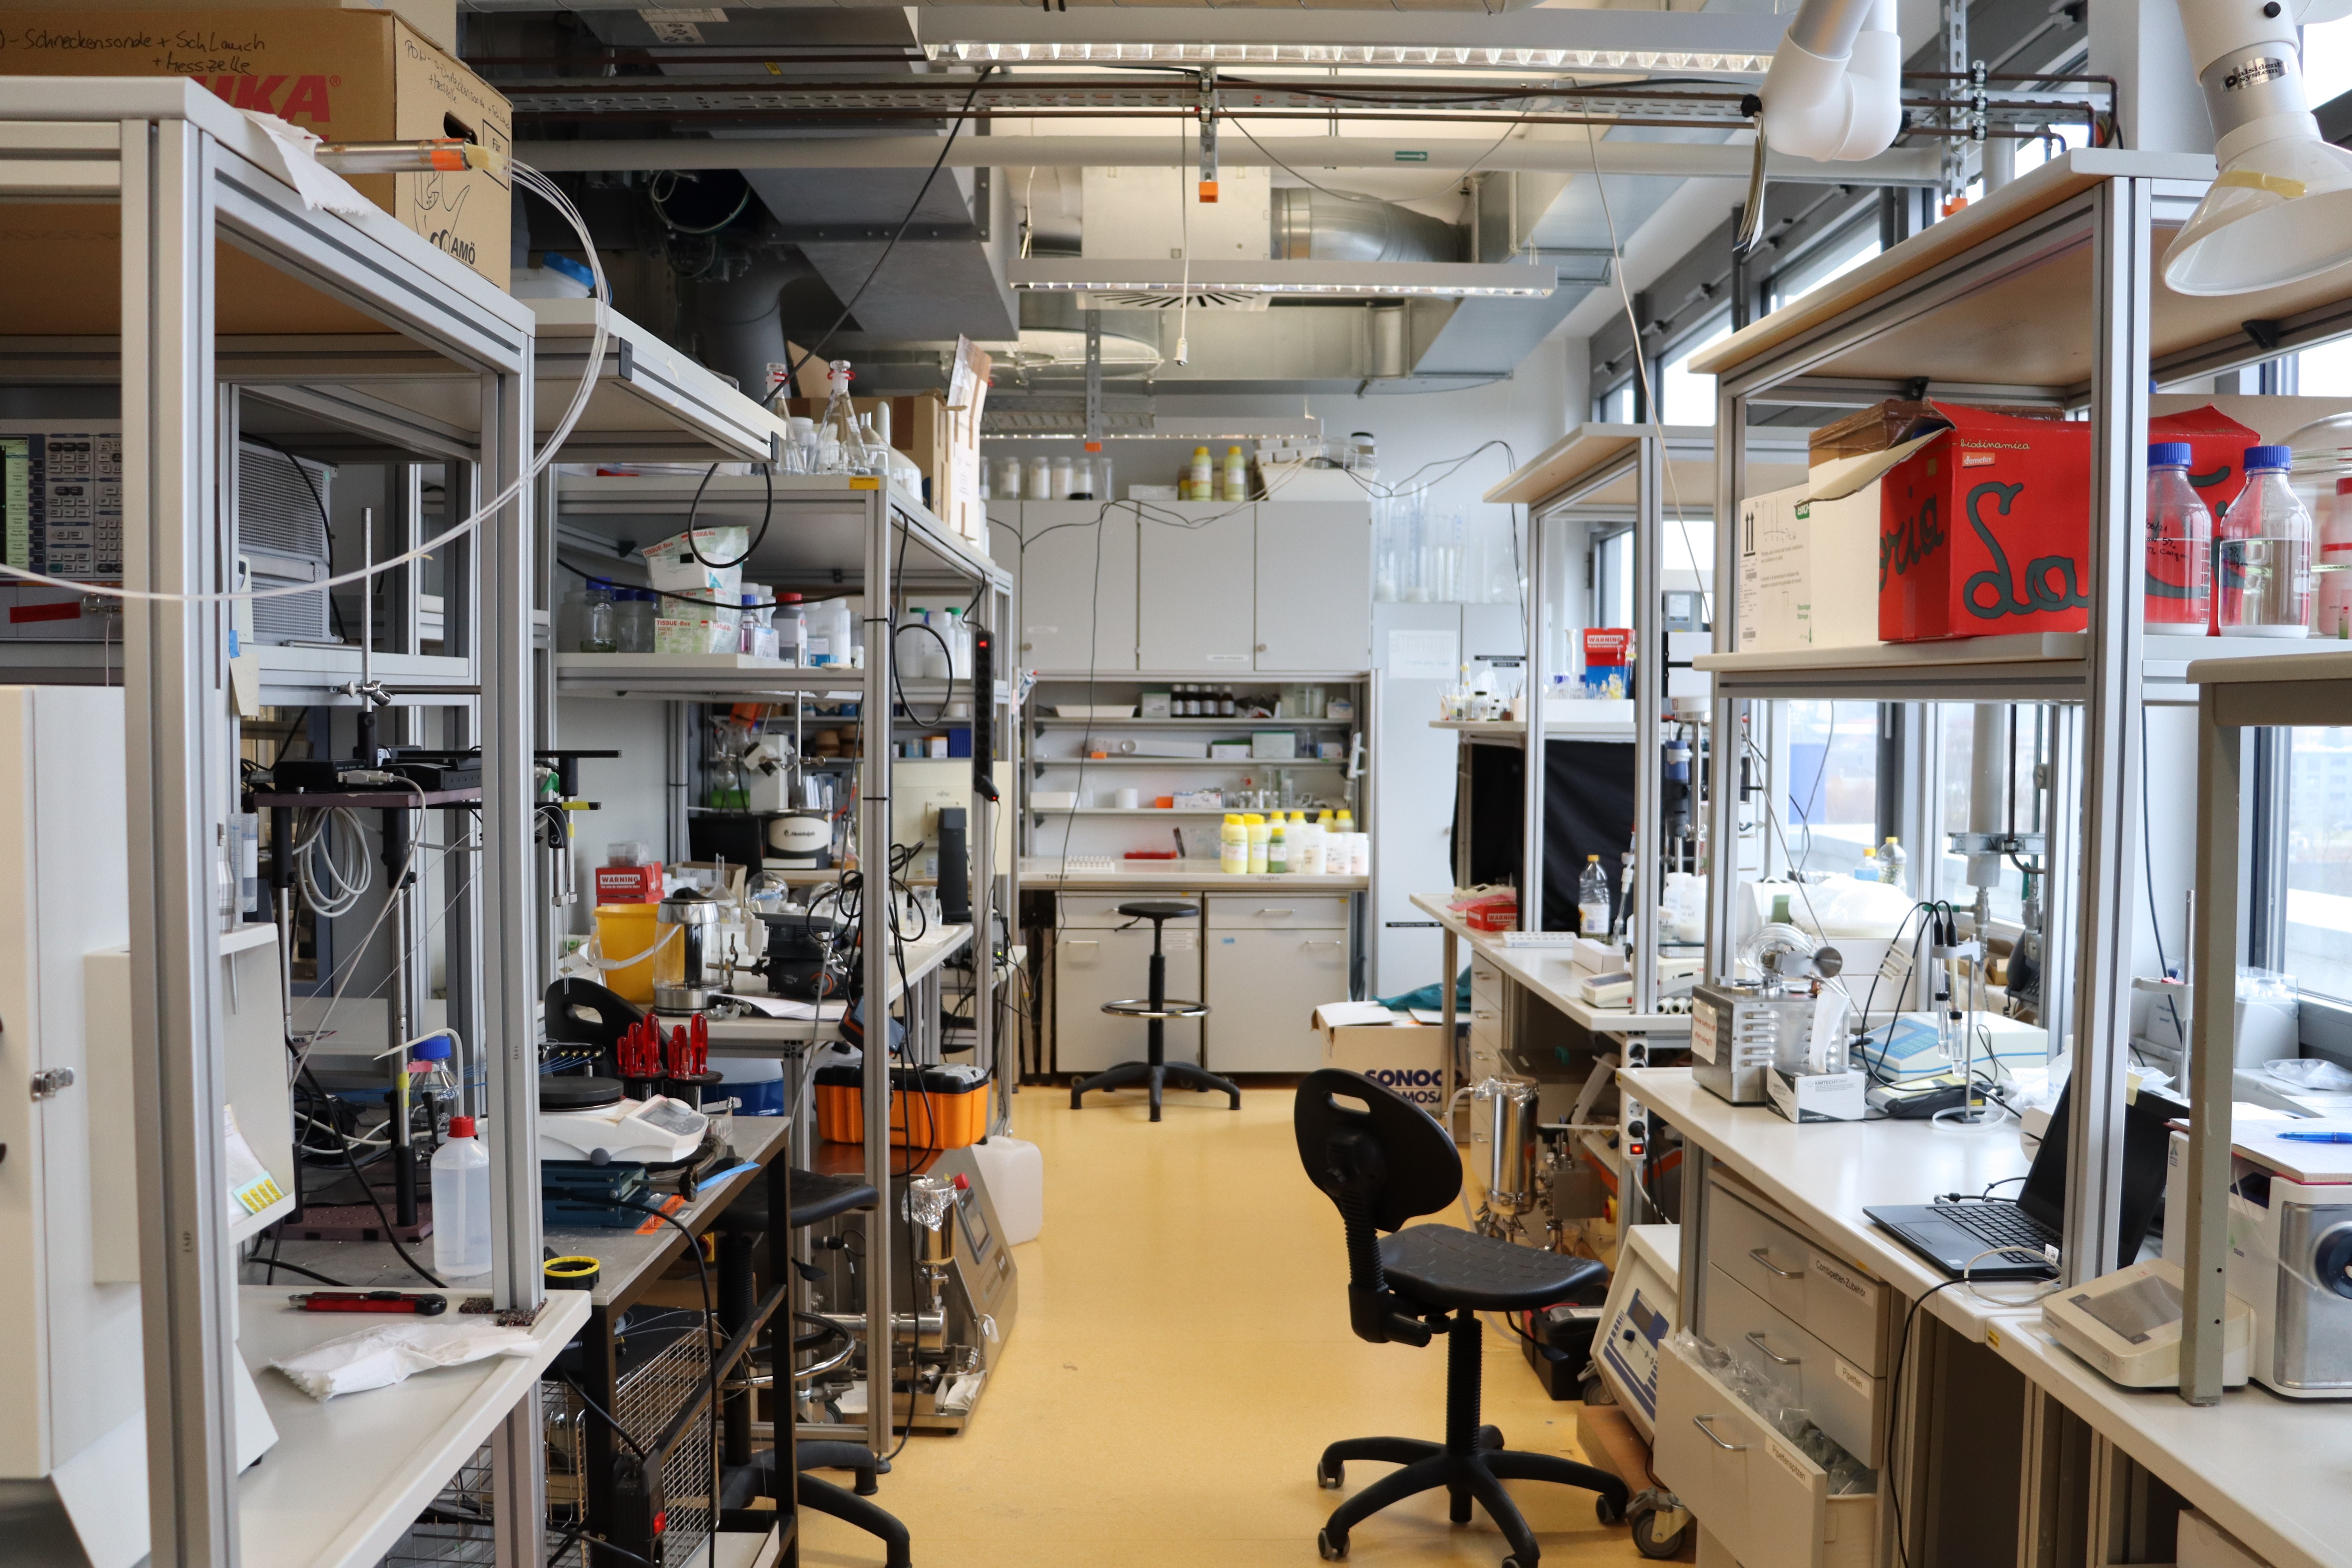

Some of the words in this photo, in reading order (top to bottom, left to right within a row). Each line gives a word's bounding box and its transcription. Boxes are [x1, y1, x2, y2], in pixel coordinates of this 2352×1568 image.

[2238, 62, 2282, 77] alsident
[2239, 68, 2279, 83] system
[492, 138, 501, 153] Für
[1960, 439, 2030, 450] biodinamica
[1964, 456, 1992, 465] demeter
[644, 541, 674, 556] TISSUE-Box
[1816, 1260, 1866, 1298] Combipetten-Zubehör
[1843, 1367, 1862, 1389] Pipetten
[1772, 1445, 1805, 1482] Pipettenspitzen
